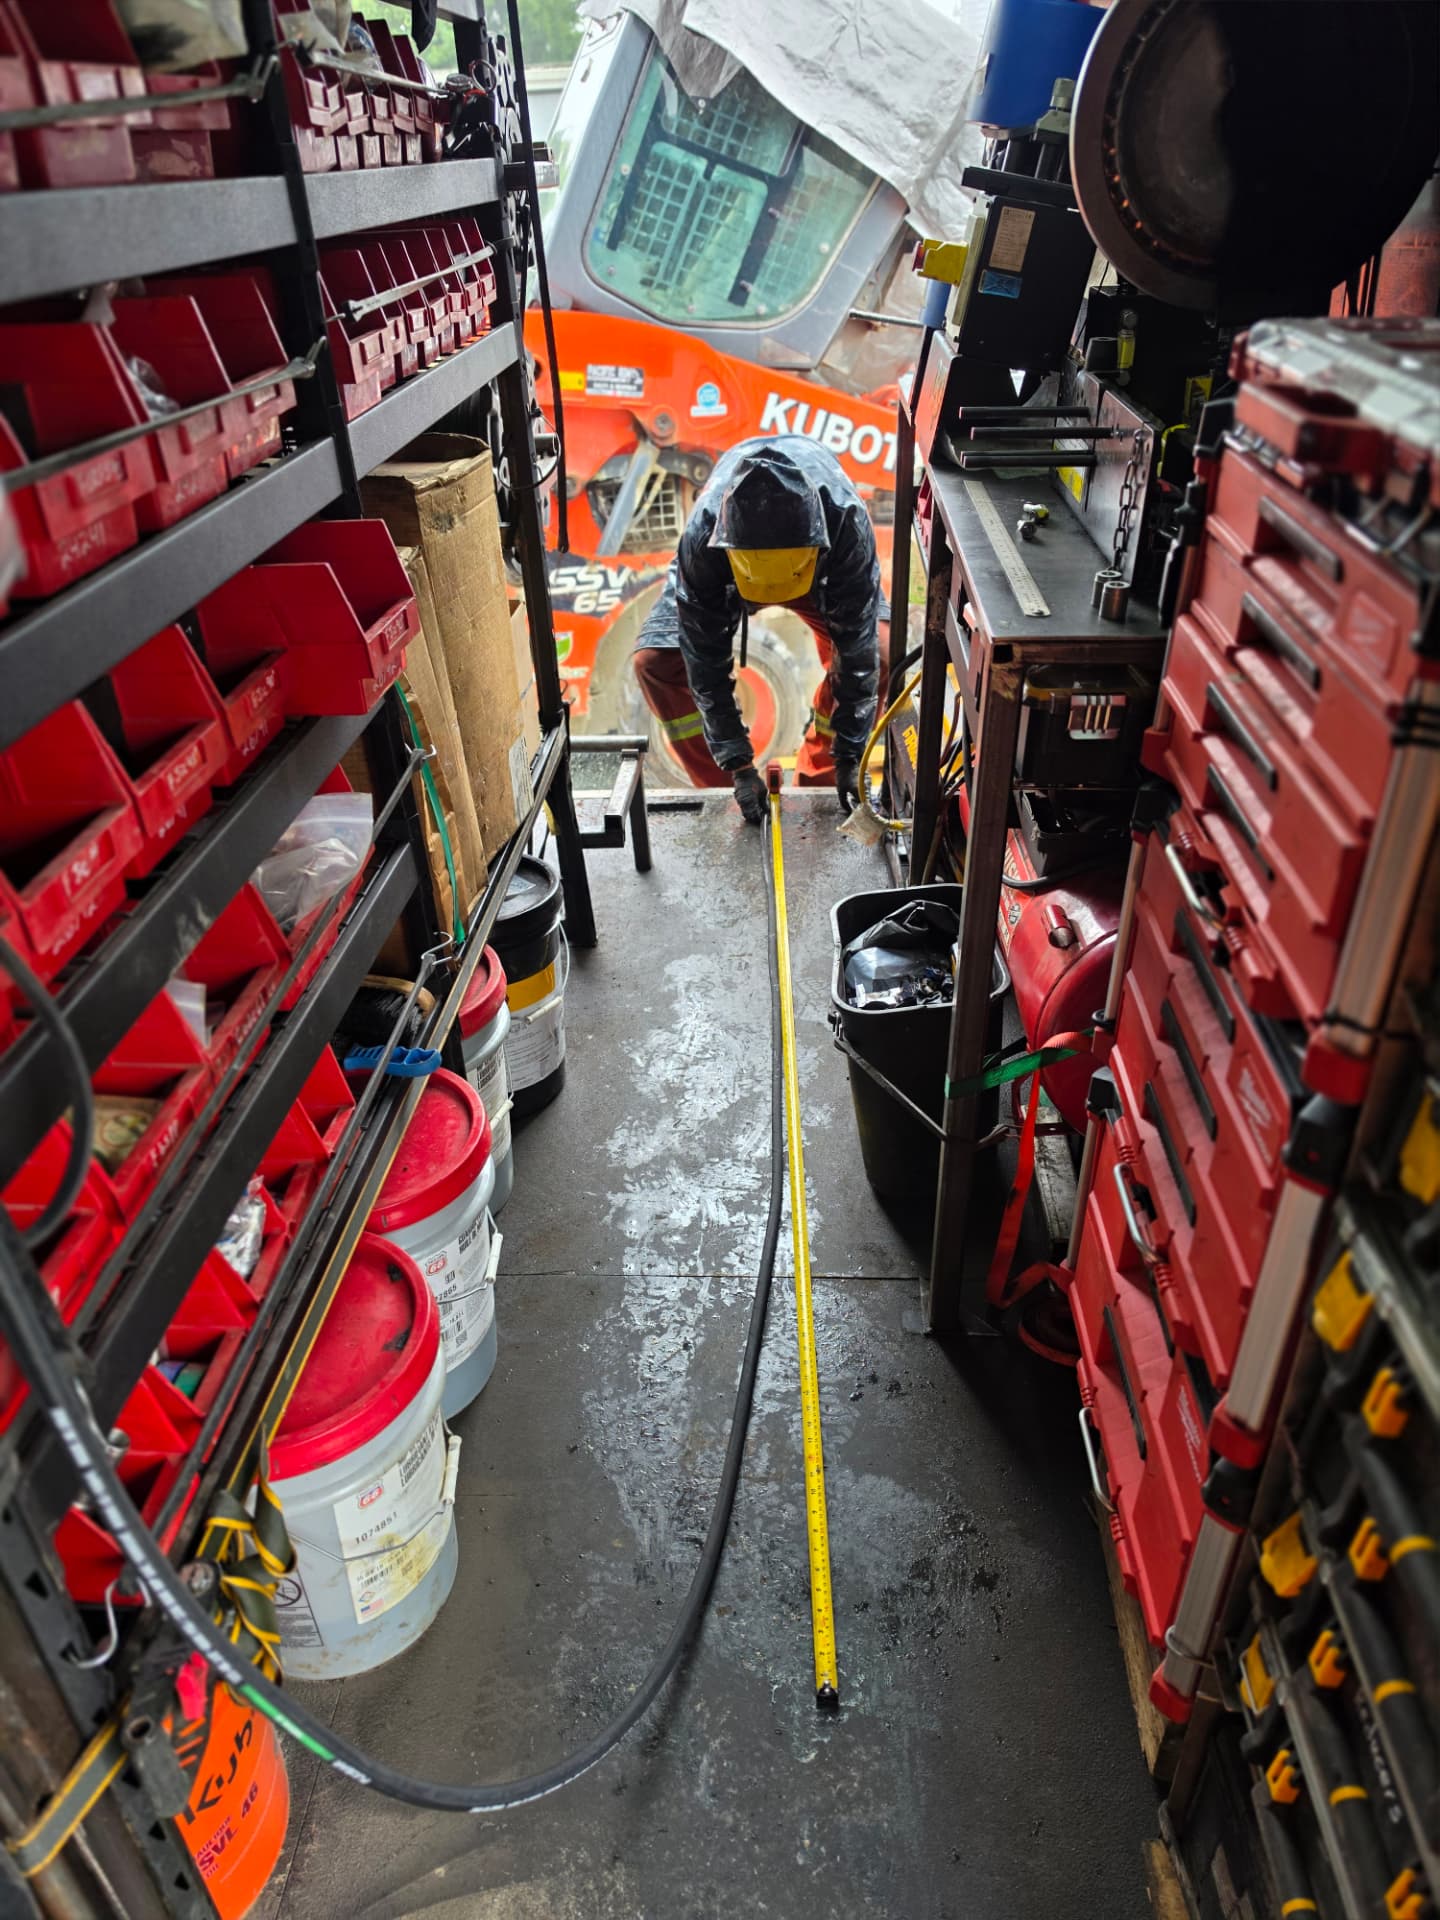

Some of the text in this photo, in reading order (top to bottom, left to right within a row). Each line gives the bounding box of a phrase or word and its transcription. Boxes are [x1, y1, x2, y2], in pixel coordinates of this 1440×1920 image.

[759, 391, 898, 472] KUBOT
[548, 563, 633, 595] SSV
[573, 588, 623, 614] 65
[198, 1826, 240, 1873] SVL
[241, 1781, 259, 1819] 46
